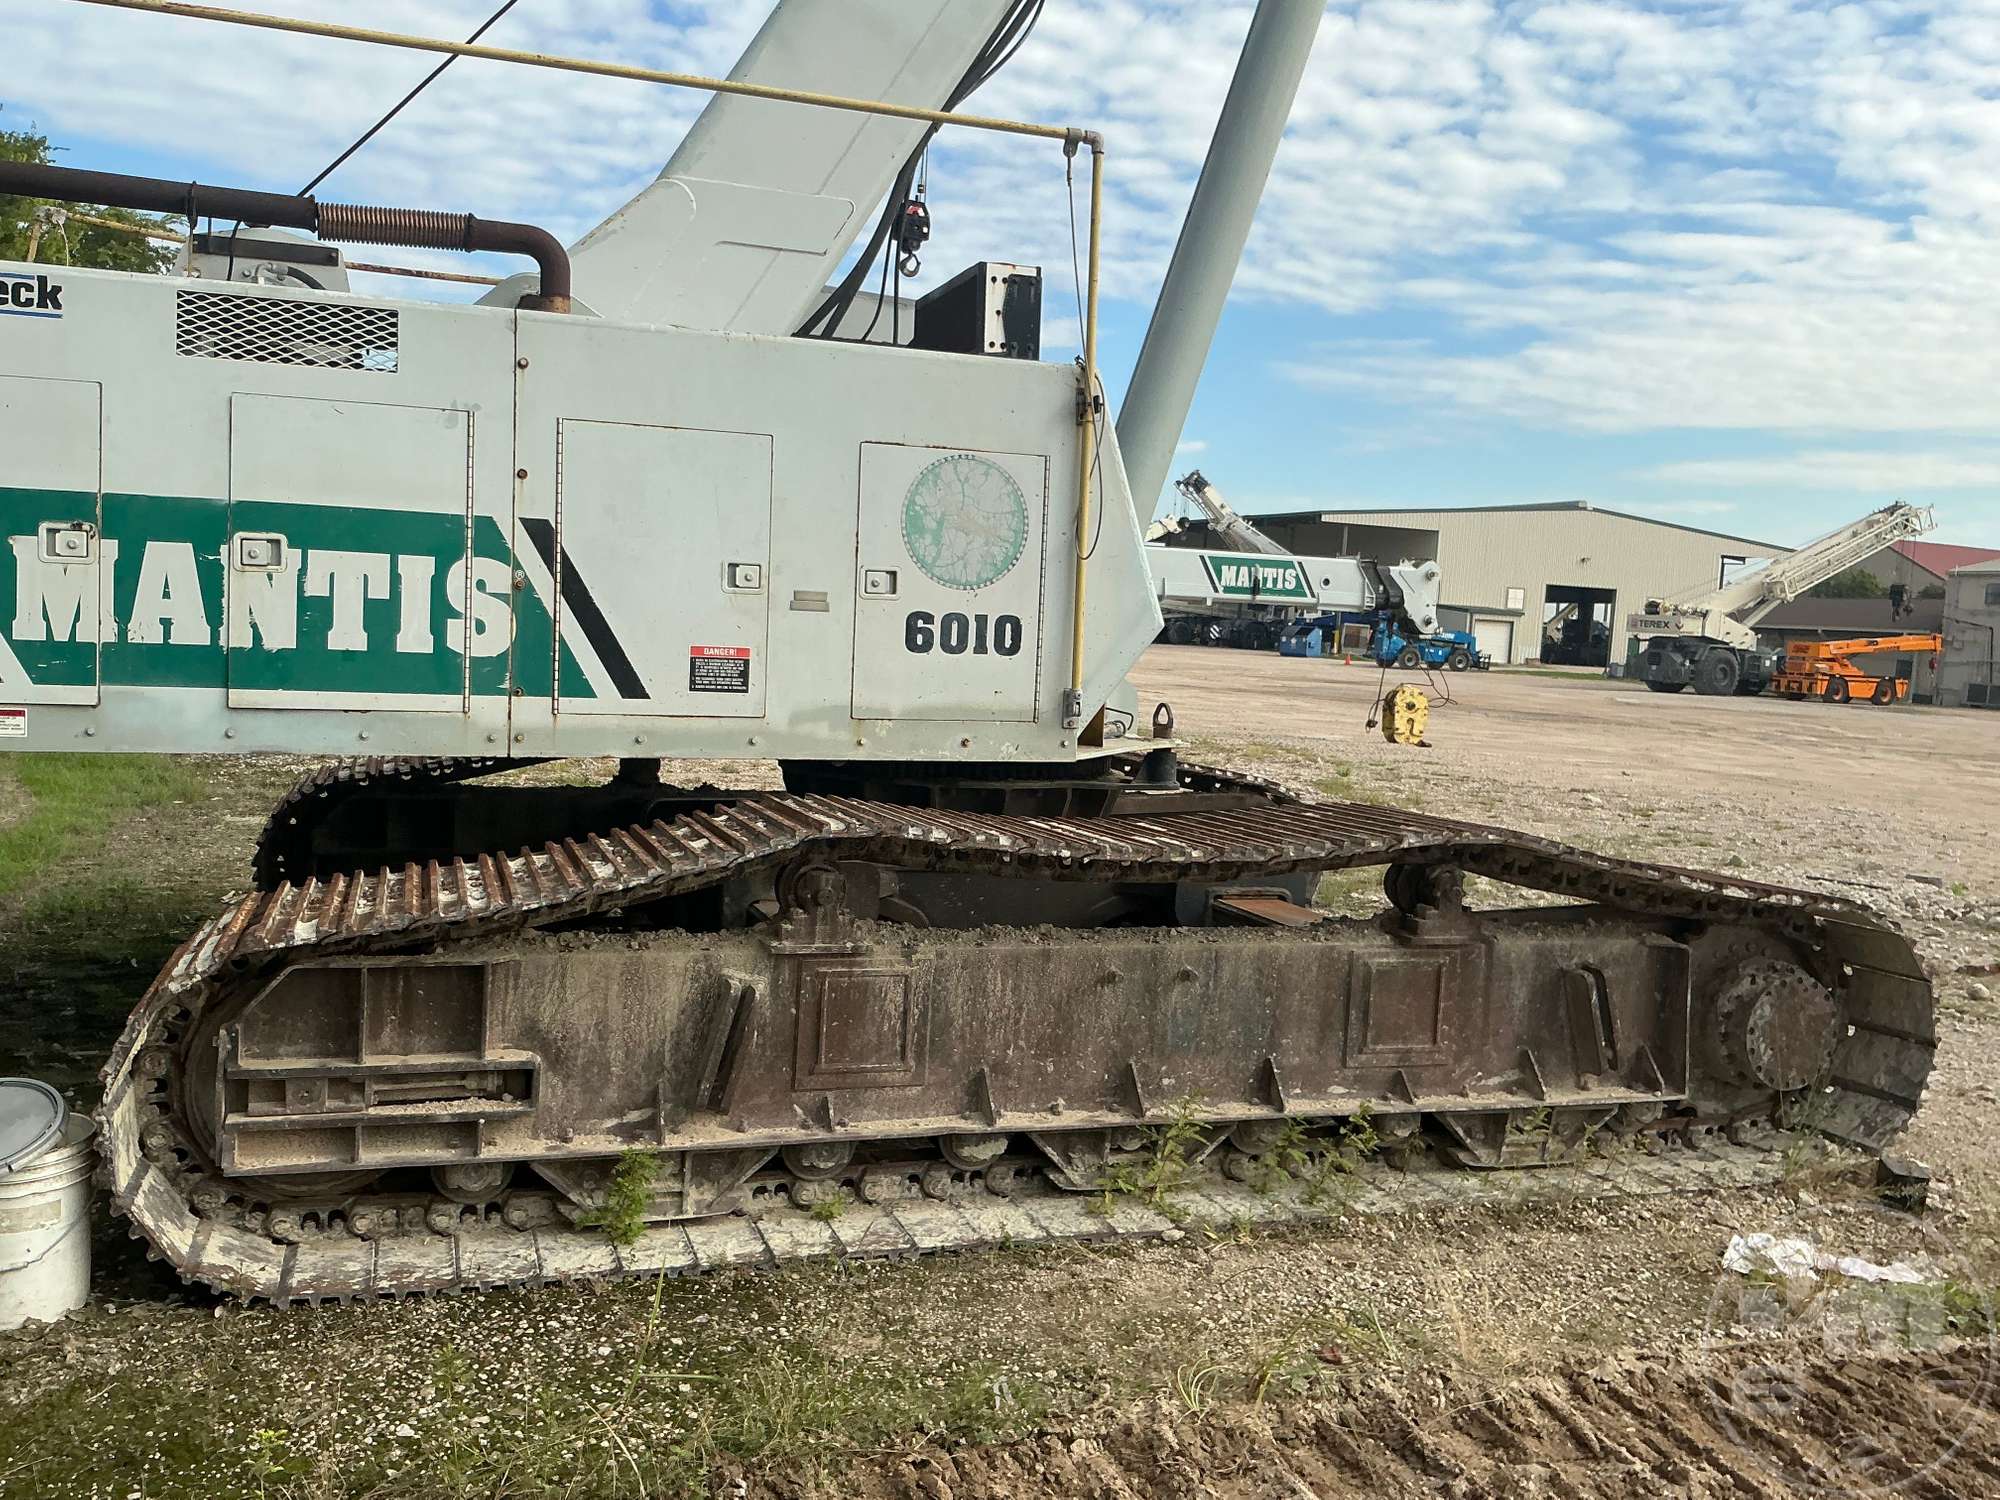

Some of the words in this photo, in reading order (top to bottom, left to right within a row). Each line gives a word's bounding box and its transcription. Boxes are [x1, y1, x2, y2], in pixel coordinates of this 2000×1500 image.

[8, 535, 517, 657] MANTIS
[905, 611, 1022, 656] 6010
[1640, 619, 1670, 629] TEREX
[704, 647, 737, 656] DANGER!
